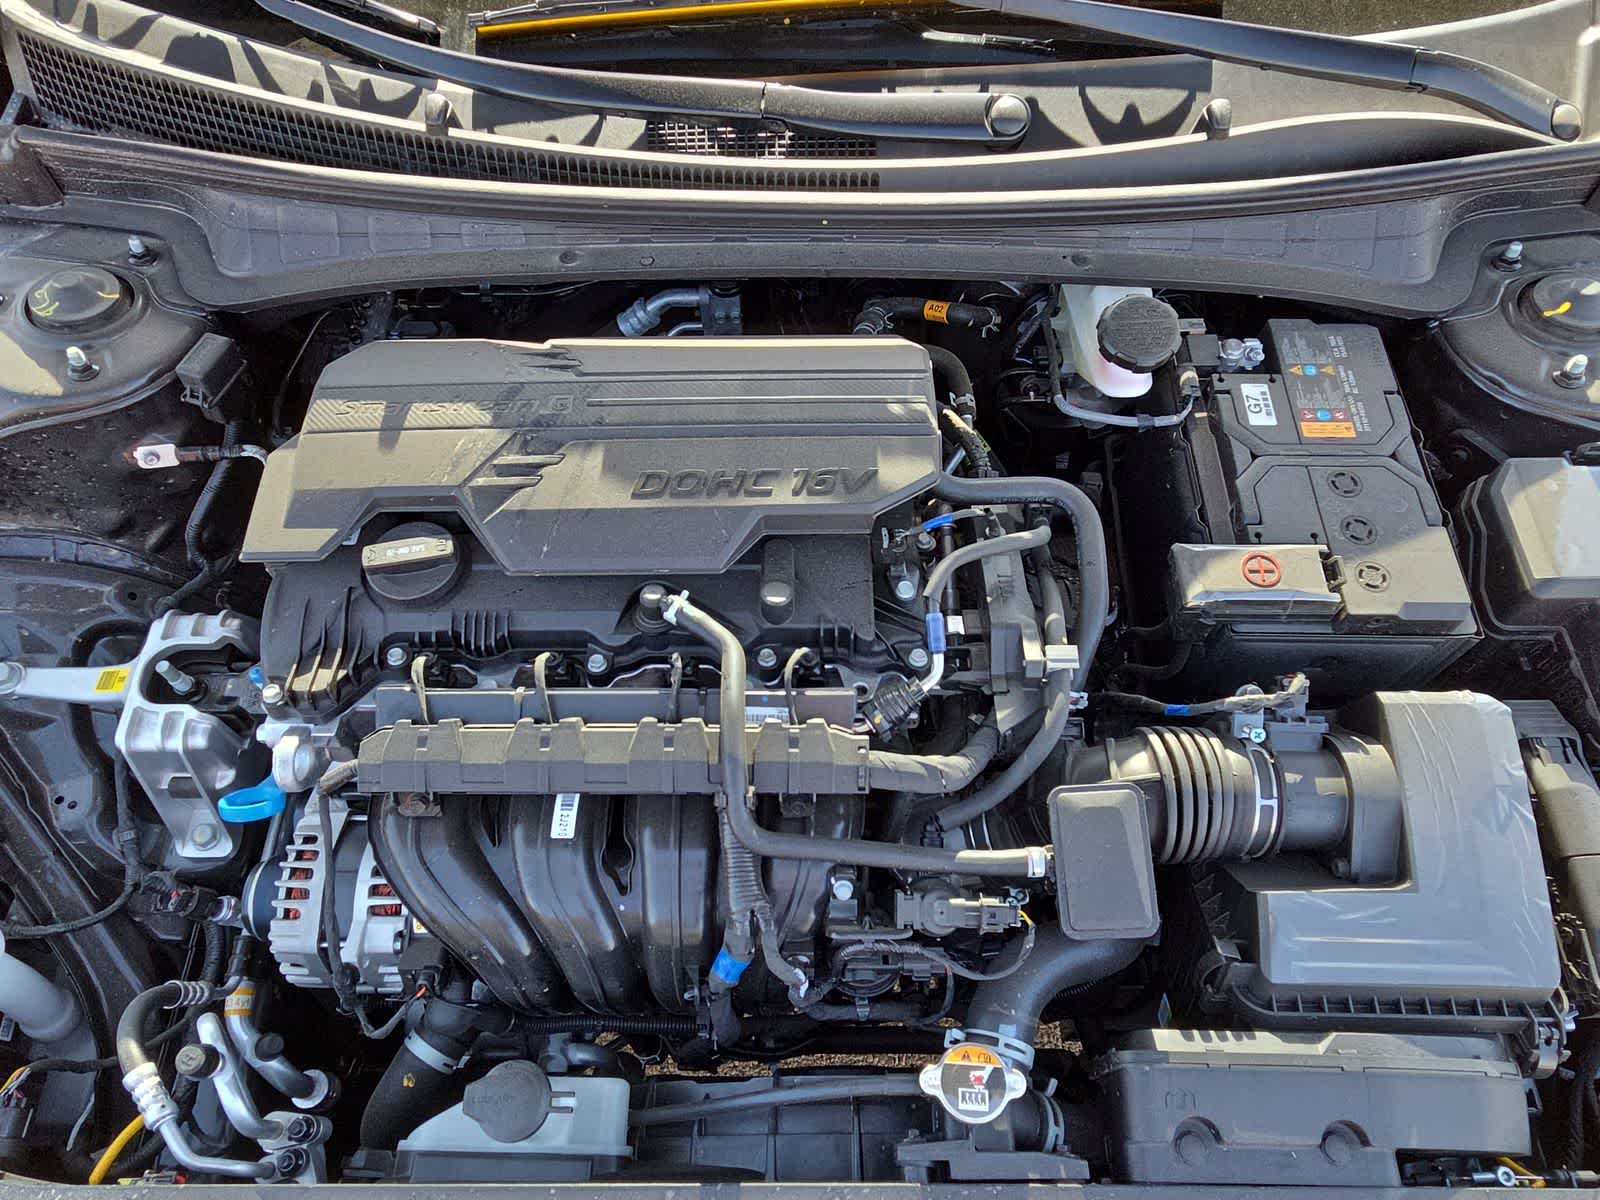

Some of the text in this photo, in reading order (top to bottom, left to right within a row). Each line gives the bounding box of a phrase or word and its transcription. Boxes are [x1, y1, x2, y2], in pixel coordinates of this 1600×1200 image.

[928, 304, 944, 313] A02
[1245, 394, 1262, 414] G7
[631, 467, 880, 500] DOHC 16V
